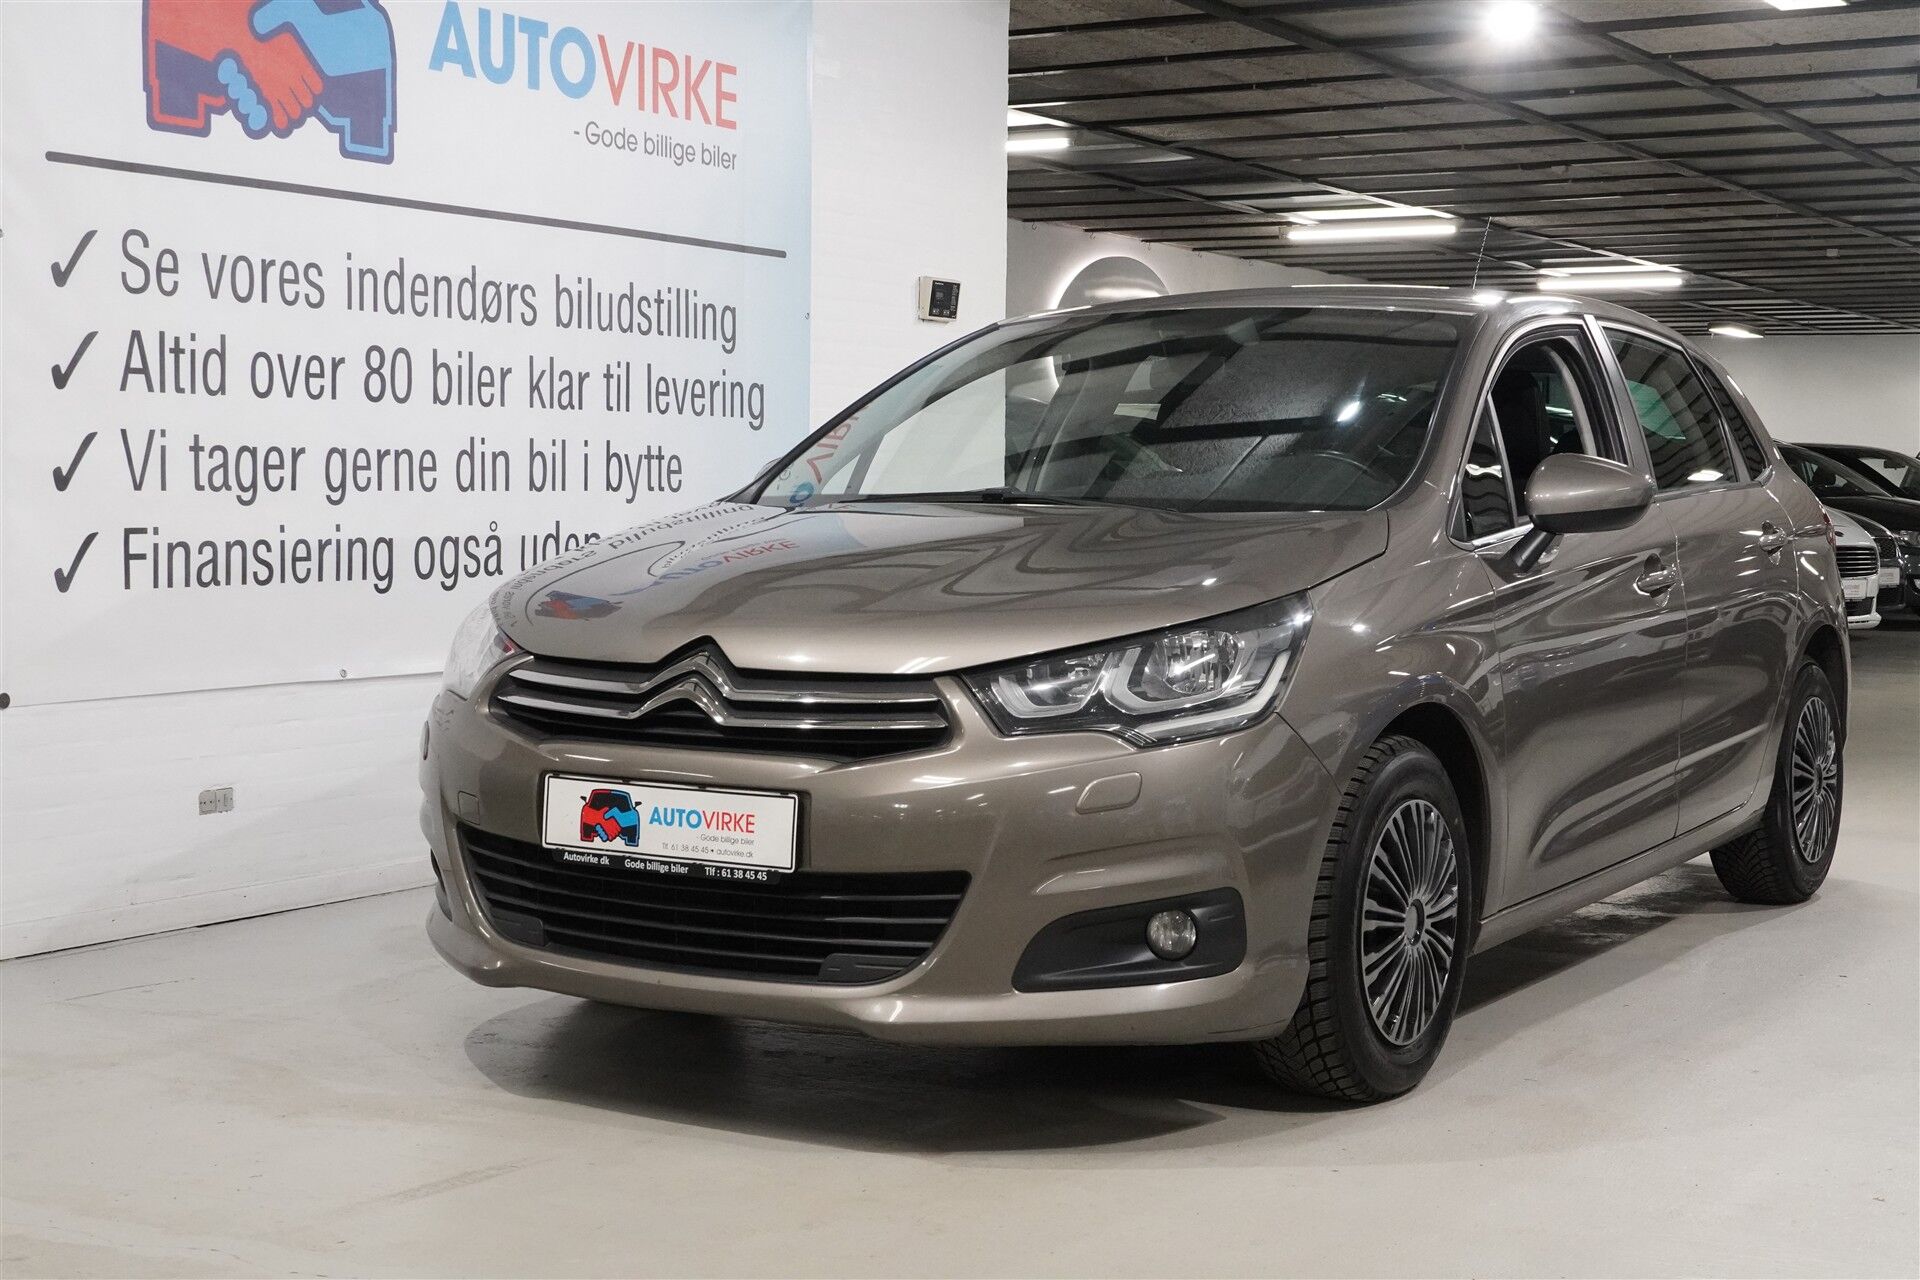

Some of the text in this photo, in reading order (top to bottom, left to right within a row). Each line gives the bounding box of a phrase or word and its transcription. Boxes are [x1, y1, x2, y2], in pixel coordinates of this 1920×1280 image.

[428, 0, 737, 130] AUTOVIRKE
[586, 121, 638, 152] Gode
[644, 132, 696, 167] billige
[701, 142, 737, 170] biler
[120, 228, 737, 355] Se vores indendørs biludstilling
[119, 330, 765, 432] Altid over 80 biler klar til levering
[119, 429, 683, 508] Vi tager gerne din bil i bytte
[123, 523, 394, 595] Finansiering
[413, 521, 504, 592] også
[648, 806, 756, 834] AUTOVIRKE
[624, 859, 645, 870] Gode
[646, 860, 670, 873] billige
[671, 863, 689, 874] biler
[704, 866, 715, 876] Tlf
[721, 868, 731, 878] 61
[733, 869, 743, 879] 38
[745, 870, 755, 880] 45
[756, 871, 768, 881] 45
